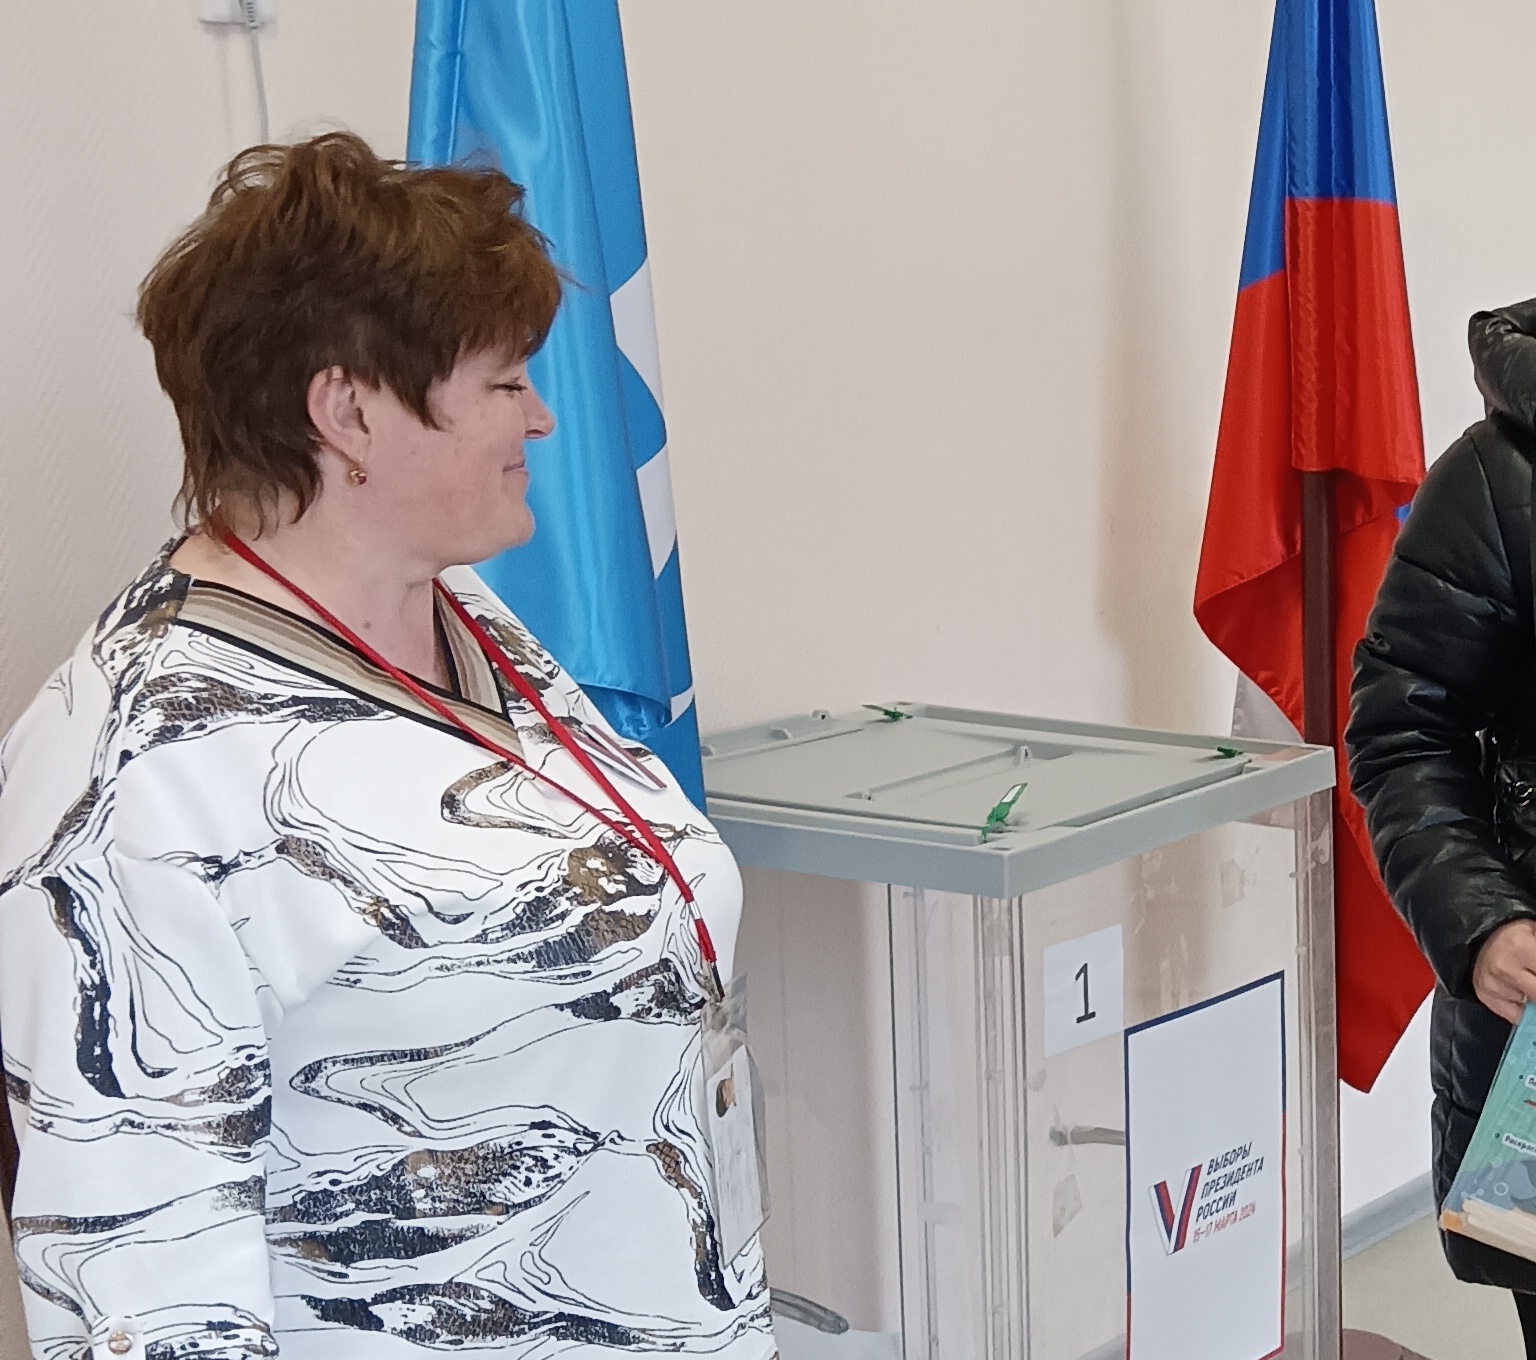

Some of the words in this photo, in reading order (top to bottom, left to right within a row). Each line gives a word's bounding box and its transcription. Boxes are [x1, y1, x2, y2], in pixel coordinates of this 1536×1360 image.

[1074, 962, 1096, 1024] 1
[1200, 1155, 1265, 1200] ПРЕЗИДЕНТА
[1206, 1140, 1253, 1176] ВЫБОРЫ
[1195, 1189, 1237, 1224] РОССИИ
